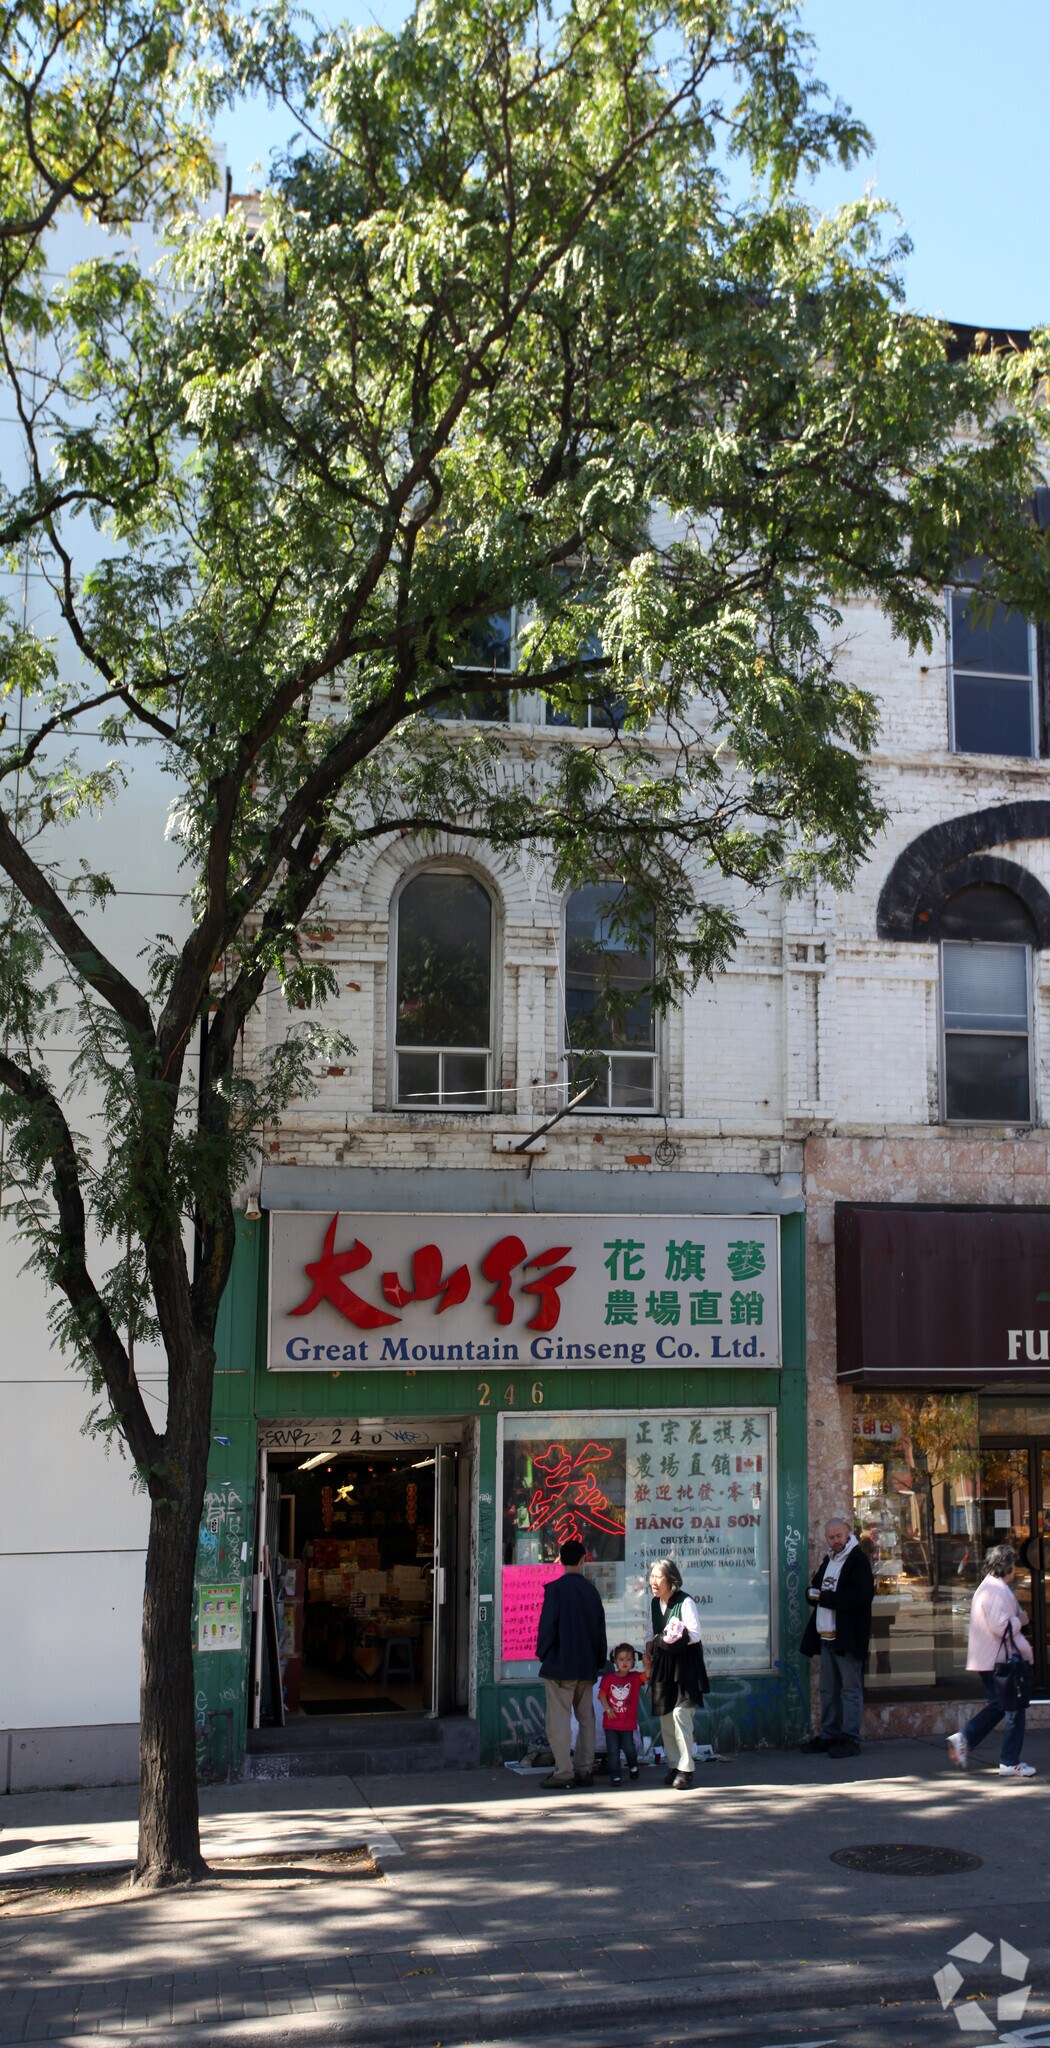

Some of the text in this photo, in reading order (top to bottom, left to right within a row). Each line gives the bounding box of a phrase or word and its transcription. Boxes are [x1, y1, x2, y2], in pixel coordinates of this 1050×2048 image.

[287, 1211, 577, 1331] 大山行
[603, 1239, 766, 1282] 花旗蔘
[604, 1289, 765, 1326] 農場直銷
[286, 1335, 766, 1364] Great Mountain Ginseng Co. Ltd.
[477, 1381, 544, 1406] 246
[633, 1452, 731, 1478] 農場直銷
[635, 1513, 684, 1530] HÃNG
[690, 1515, 721, 1532] ĐẠI
